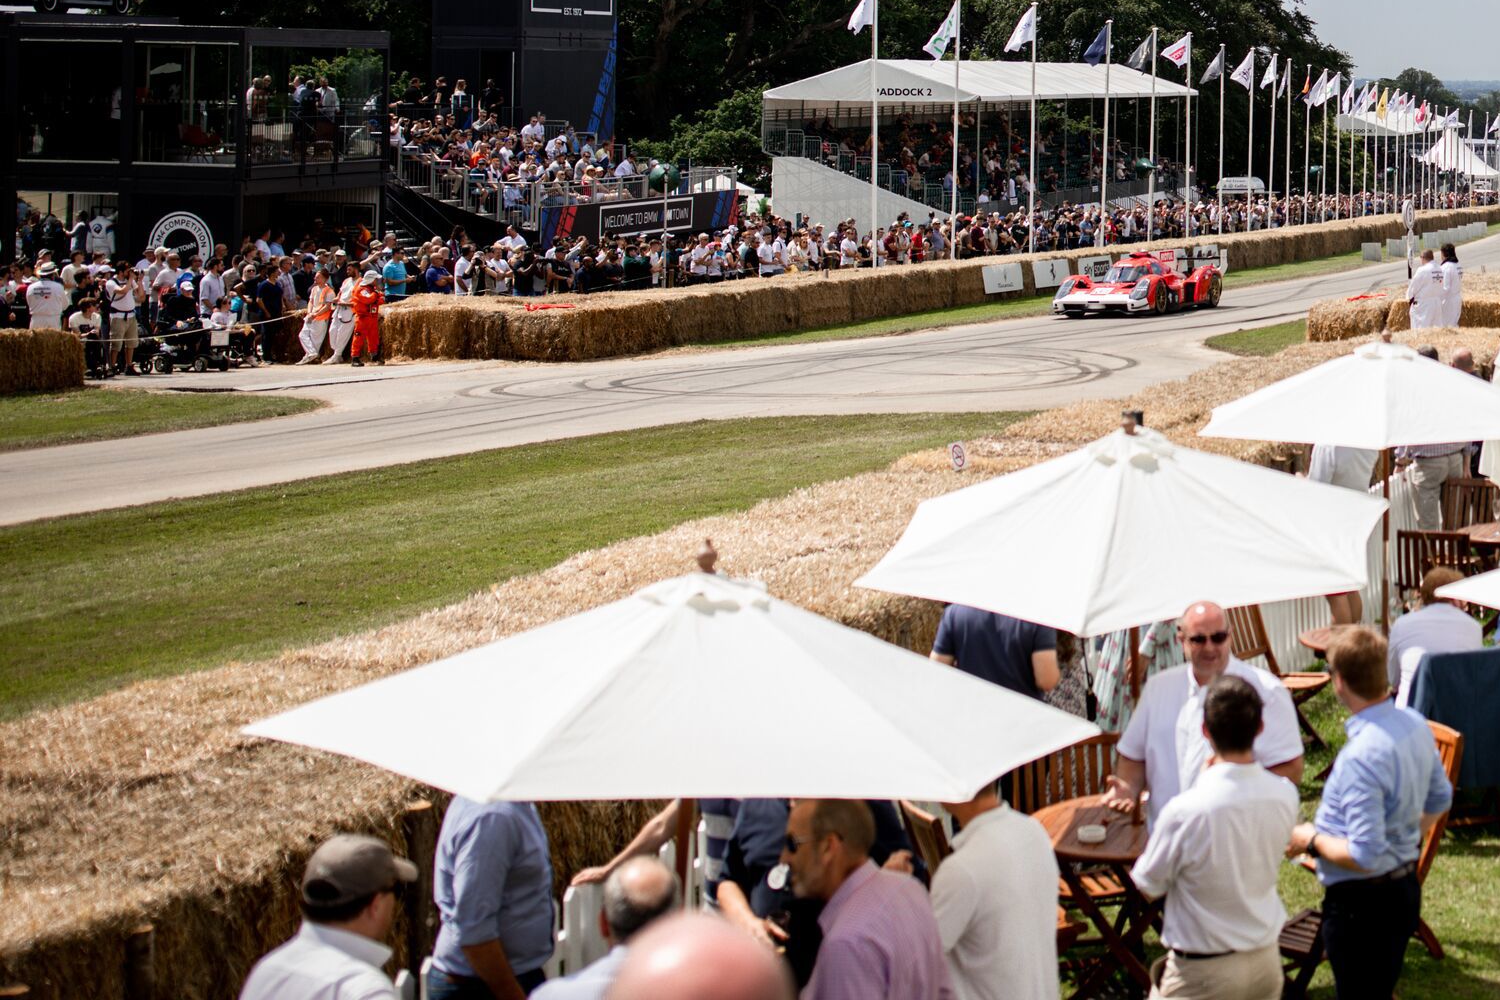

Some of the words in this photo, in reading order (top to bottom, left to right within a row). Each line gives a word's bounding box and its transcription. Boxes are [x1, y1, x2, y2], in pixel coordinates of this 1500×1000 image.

[926, 88, 932, 96] 2
[604, 215, 635, 228] WELCOME
[635, 212, 642, 225] TO
[644, 209, 658, 224] BMW
[164, 219, 207, 249] COMPETITION
